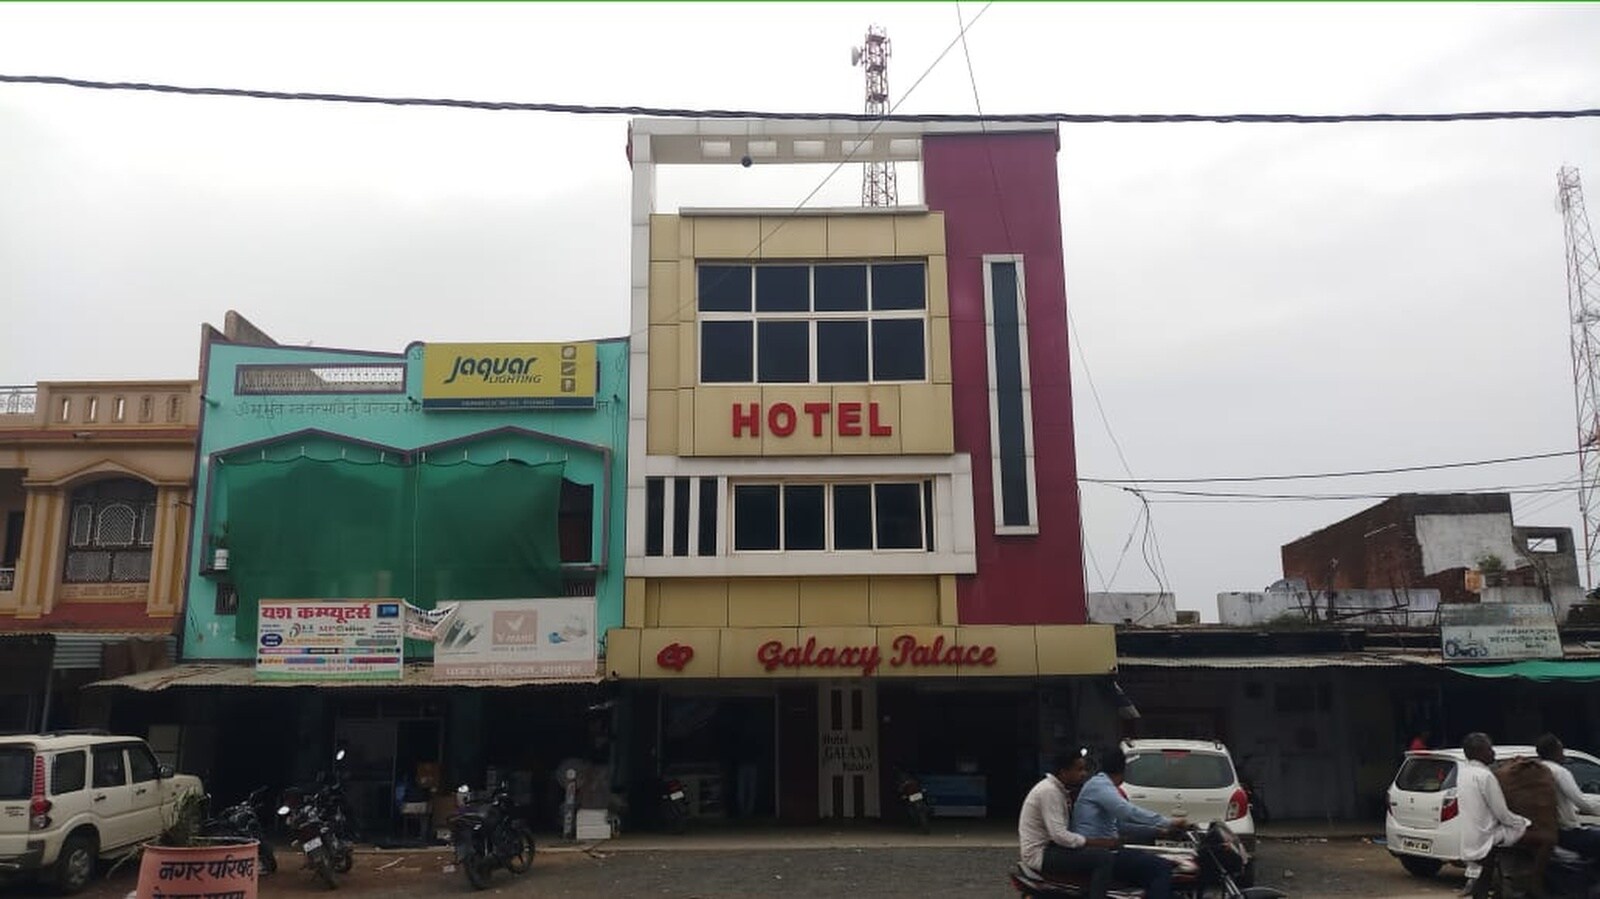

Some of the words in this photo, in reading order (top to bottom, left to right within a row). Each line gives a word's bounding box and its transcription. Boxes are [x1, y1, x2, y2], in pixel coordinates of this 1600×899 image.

[489, 373, 543, 384] LIGHTING
[732, 402, 893, 438] HOTEL
[261, 606, 293, 620] यश
[757, 637, 881, 676] Galaxy
[889, 634, 998, 668] Palace
[159, 861, 205, 881] नगर
